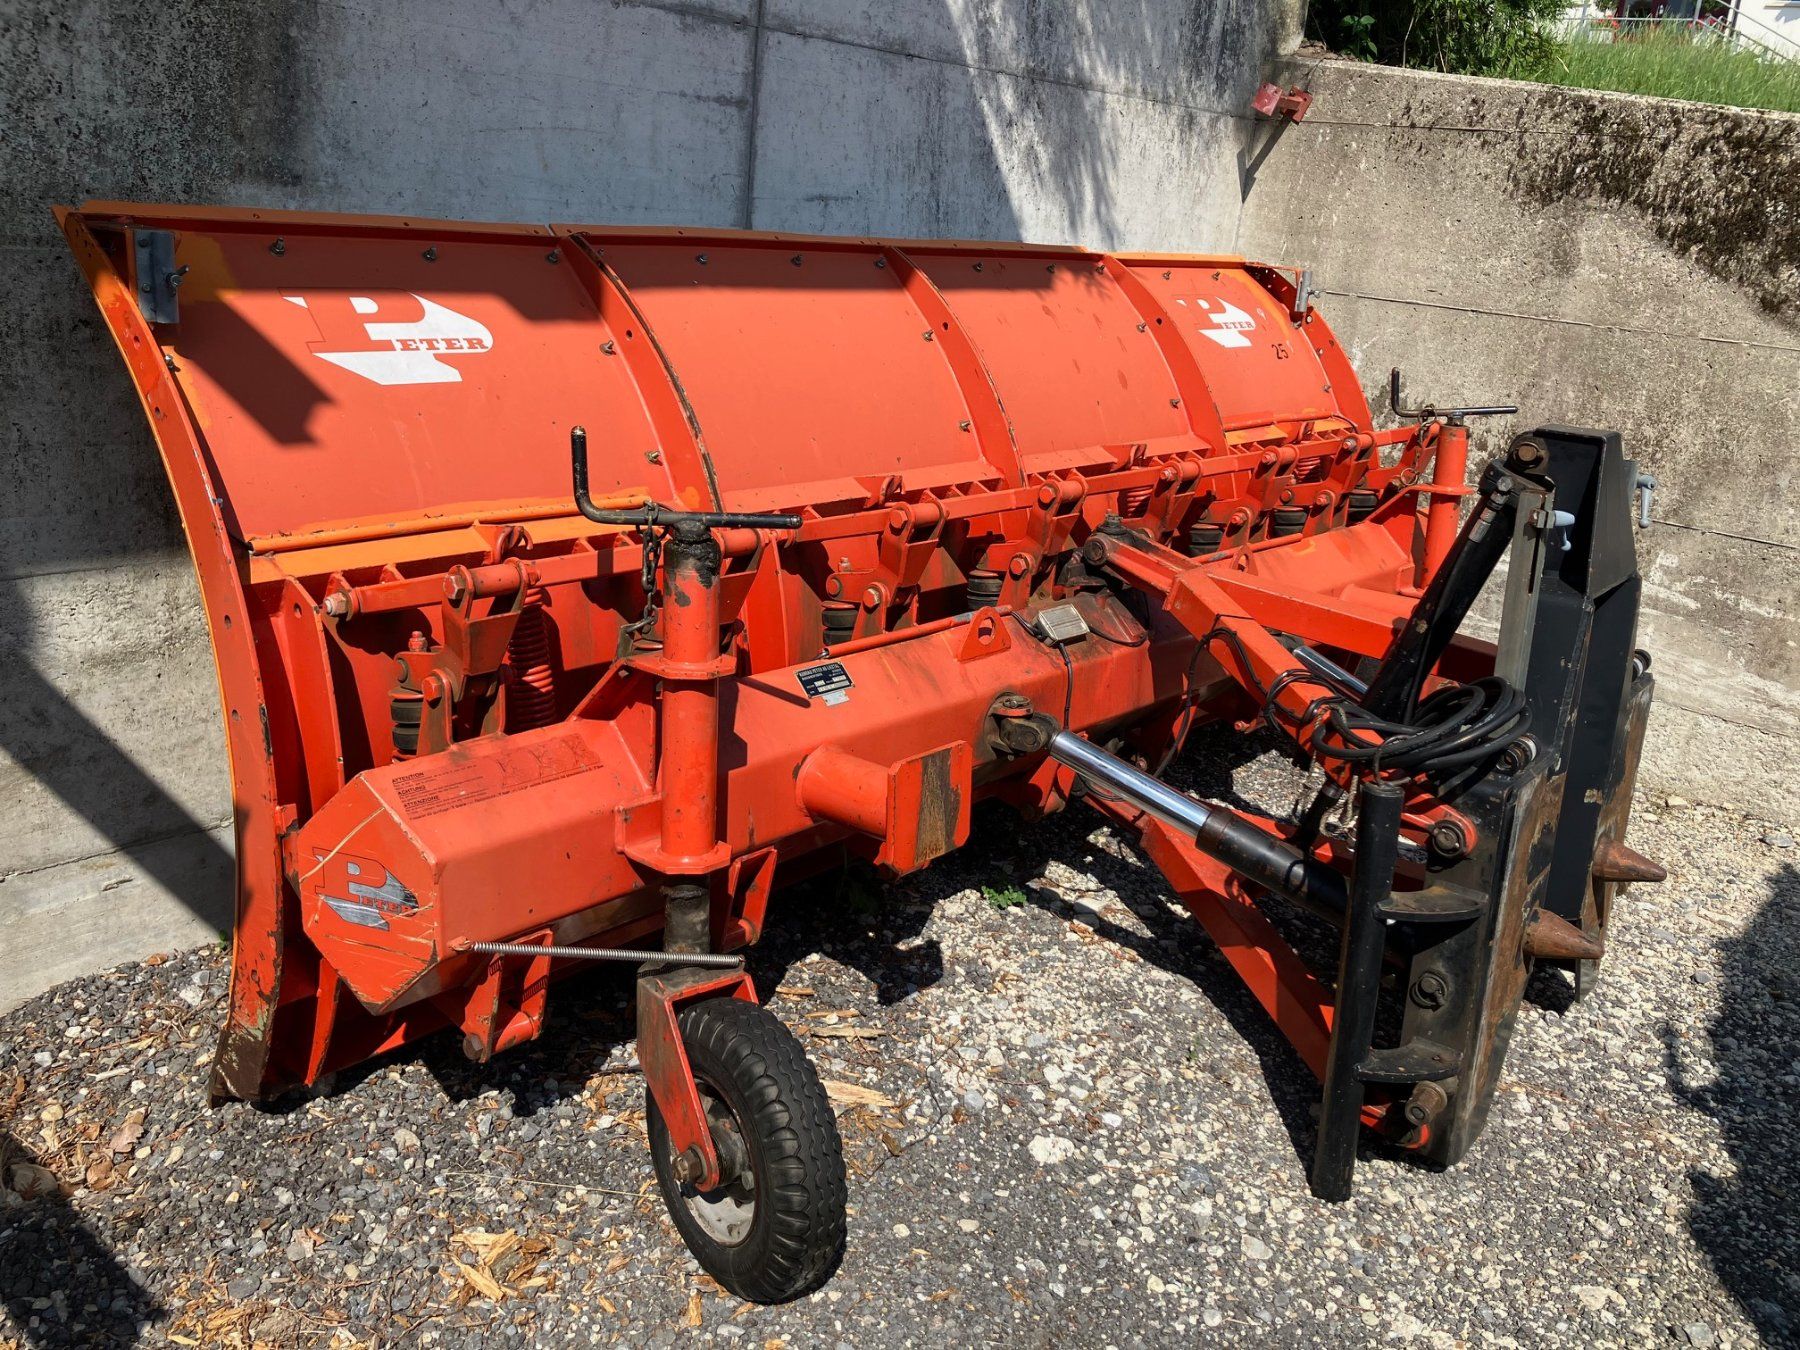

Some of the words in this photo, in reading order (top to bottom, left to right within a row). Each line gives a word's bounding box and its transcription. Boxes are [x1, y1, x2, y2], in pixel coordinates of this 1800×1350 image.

[278, 287, 493, 353] PETER
[1271, 343, 1289, 360] 25
[391, 771, 425, 784] ATTENTION
[397, 784, 427, 796] ACHTUNG
[403, 794, 440, 808] ATTENZIONE
